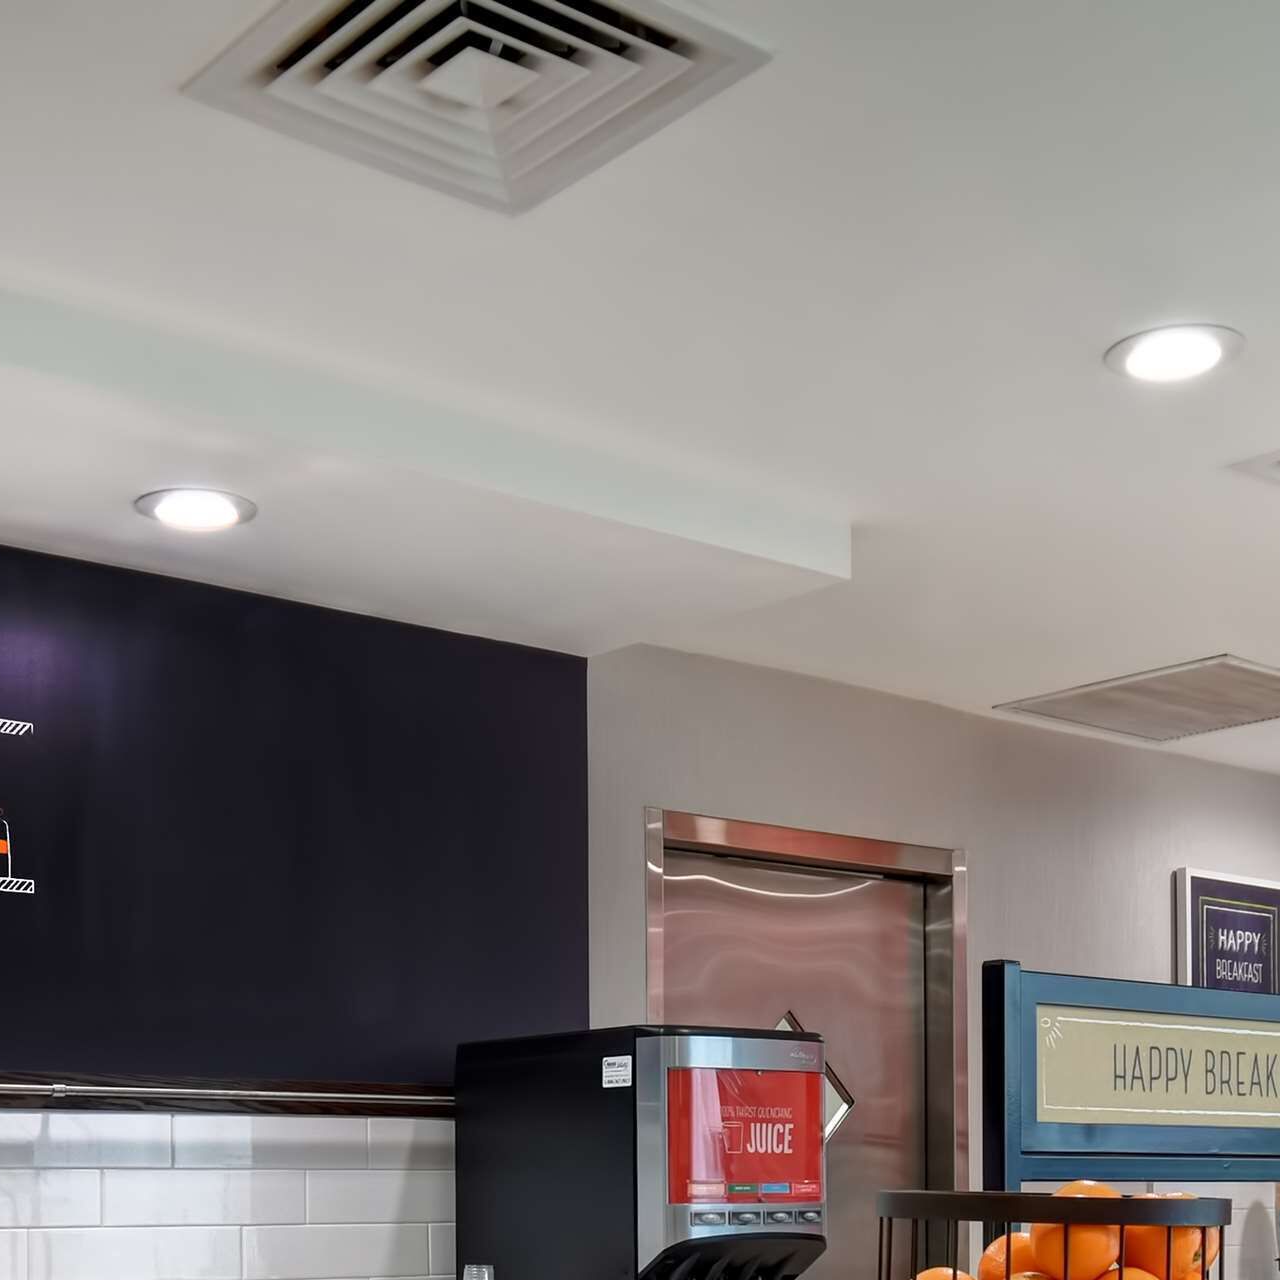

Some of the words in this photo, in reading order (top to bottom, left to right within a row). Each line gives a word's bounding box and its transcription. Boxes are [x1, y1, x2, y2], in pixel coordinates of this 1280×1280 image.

[1218, 928, 1261, 955] HAPPY
[1216, 958, 1263, 984] BREAKFAST
[1113, 1044, 1192, 1095] HAPPY
[746, 1123, 795, 1154] JUICE
